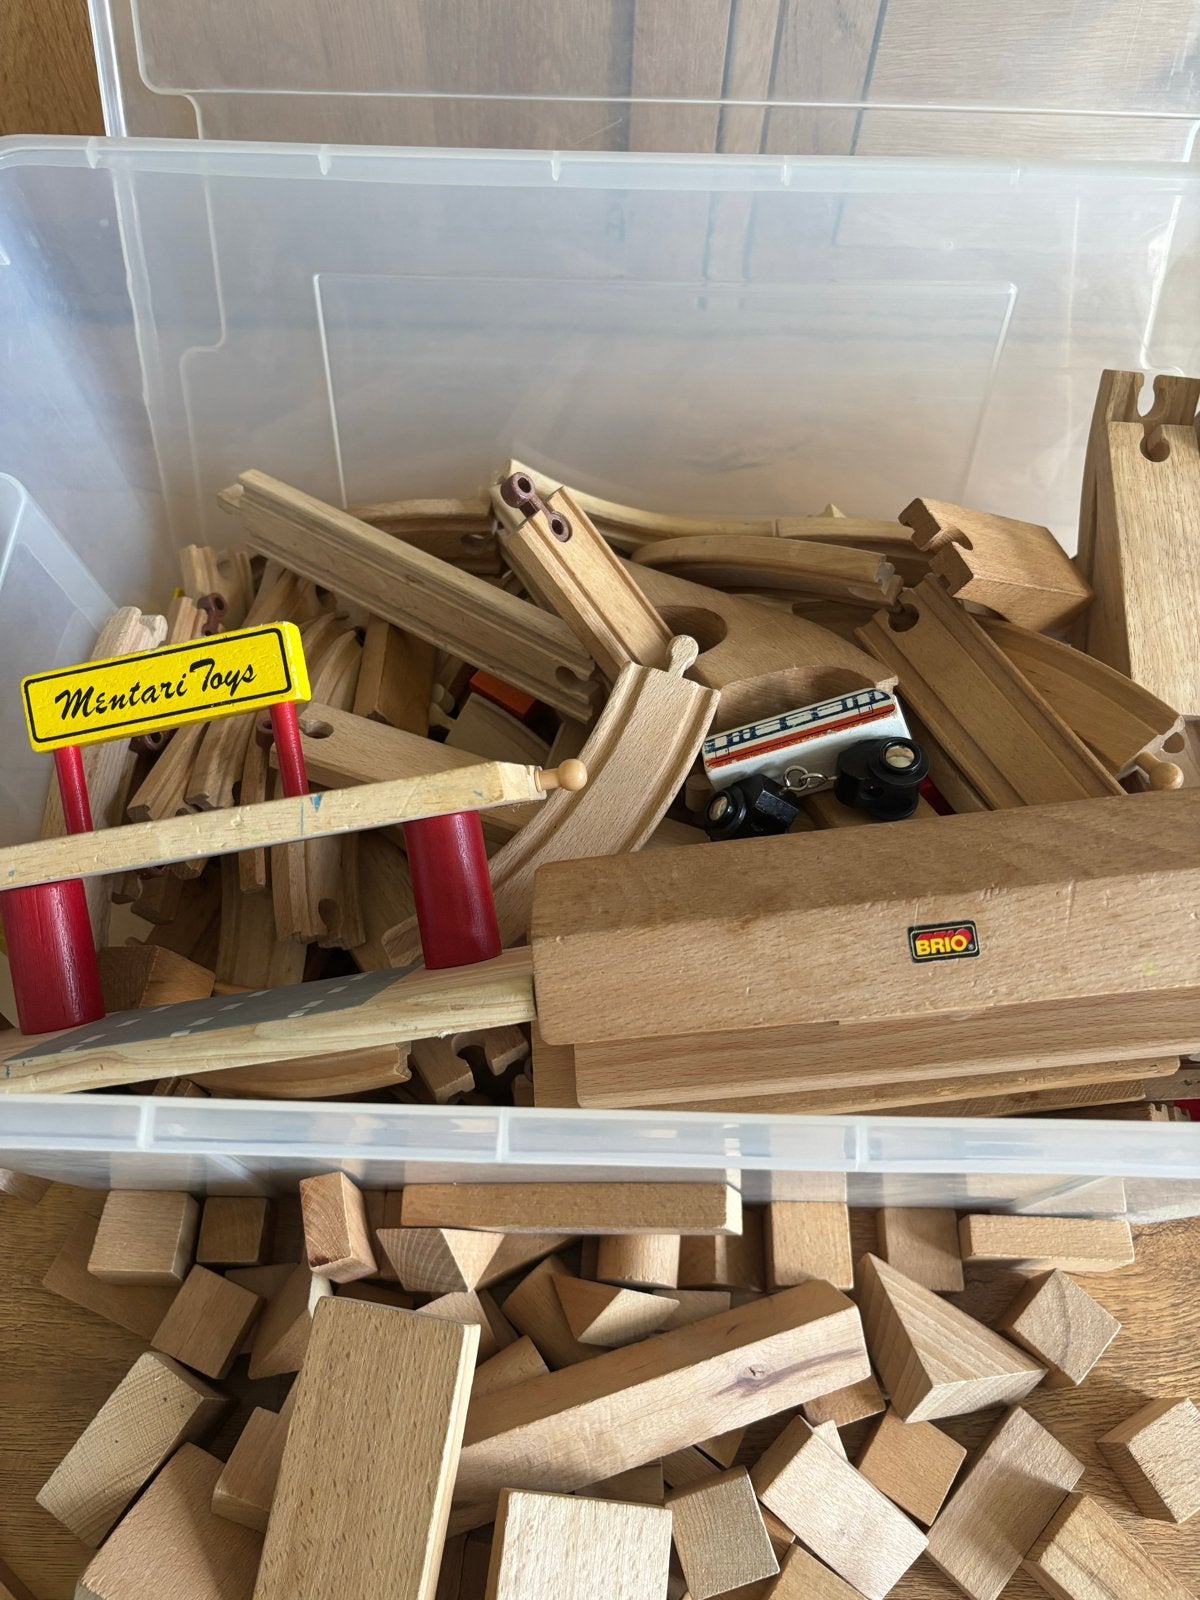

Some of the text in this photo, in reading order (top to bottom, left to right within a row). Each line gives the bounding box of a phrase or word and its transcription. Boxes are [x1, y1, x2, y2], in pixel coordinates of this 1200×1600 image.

[55, 658, 257, 720] Mentari Toys
[915, 933, 968, 956] BRIO
